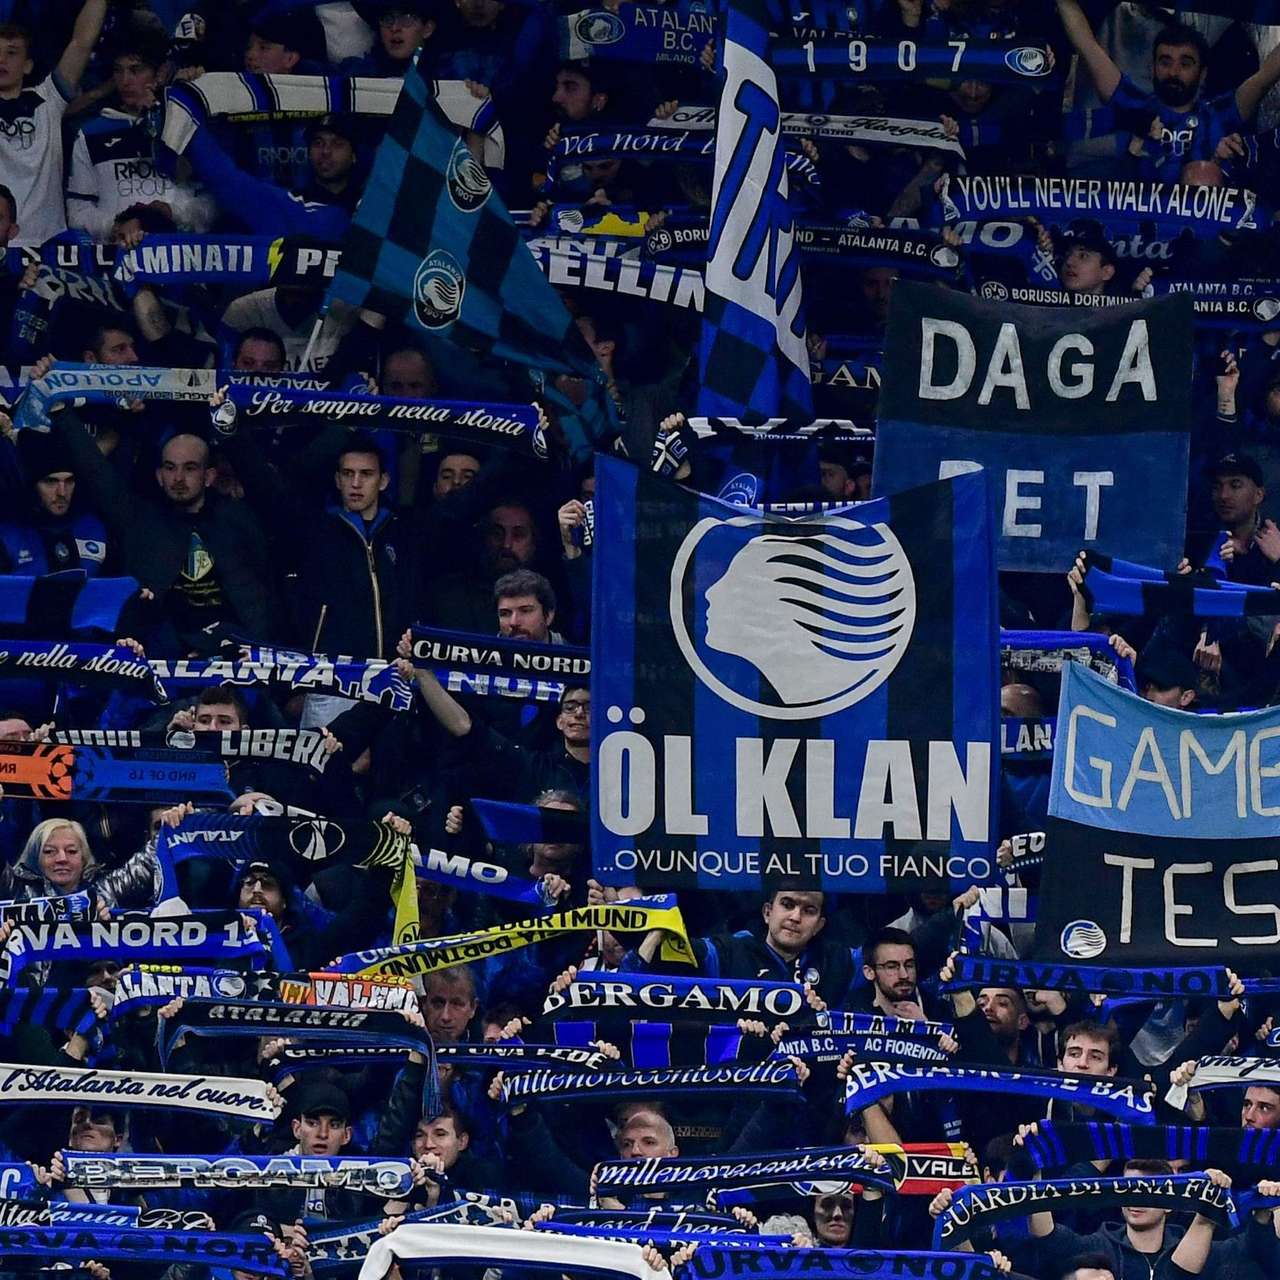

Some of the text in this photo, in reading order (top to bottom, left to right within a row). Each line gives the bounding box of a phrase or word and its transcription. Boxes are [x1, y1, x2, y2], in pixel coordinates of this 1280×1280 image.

[956, 176, 1239, 220] YOU'LL NEVER WALK ALONE
[838, 232, 898, 253] ATALANTA
[1012, 288, 1069, 306] BORUSSIA
[919, 317, 1157, 410] DAGA
[302, 398, 526, 438] sempre storia
[18, 647, 149, 678] nella storia
[413, 639, 592, 674] CURVA NORD
[597, 706, 991, 842] ÖL KLAN
[765, 854, 801, 878] AL
[804, 854, 875, 878] TUO
[878, 855, 991, 880] FIANCO
[91, 921, 208, 948] NORD
[541, 980, 802, 1016] BERGAMO
[209, 1004, 366, 1028] ATALANTA
[149, 1080, 190, 1100] nel
